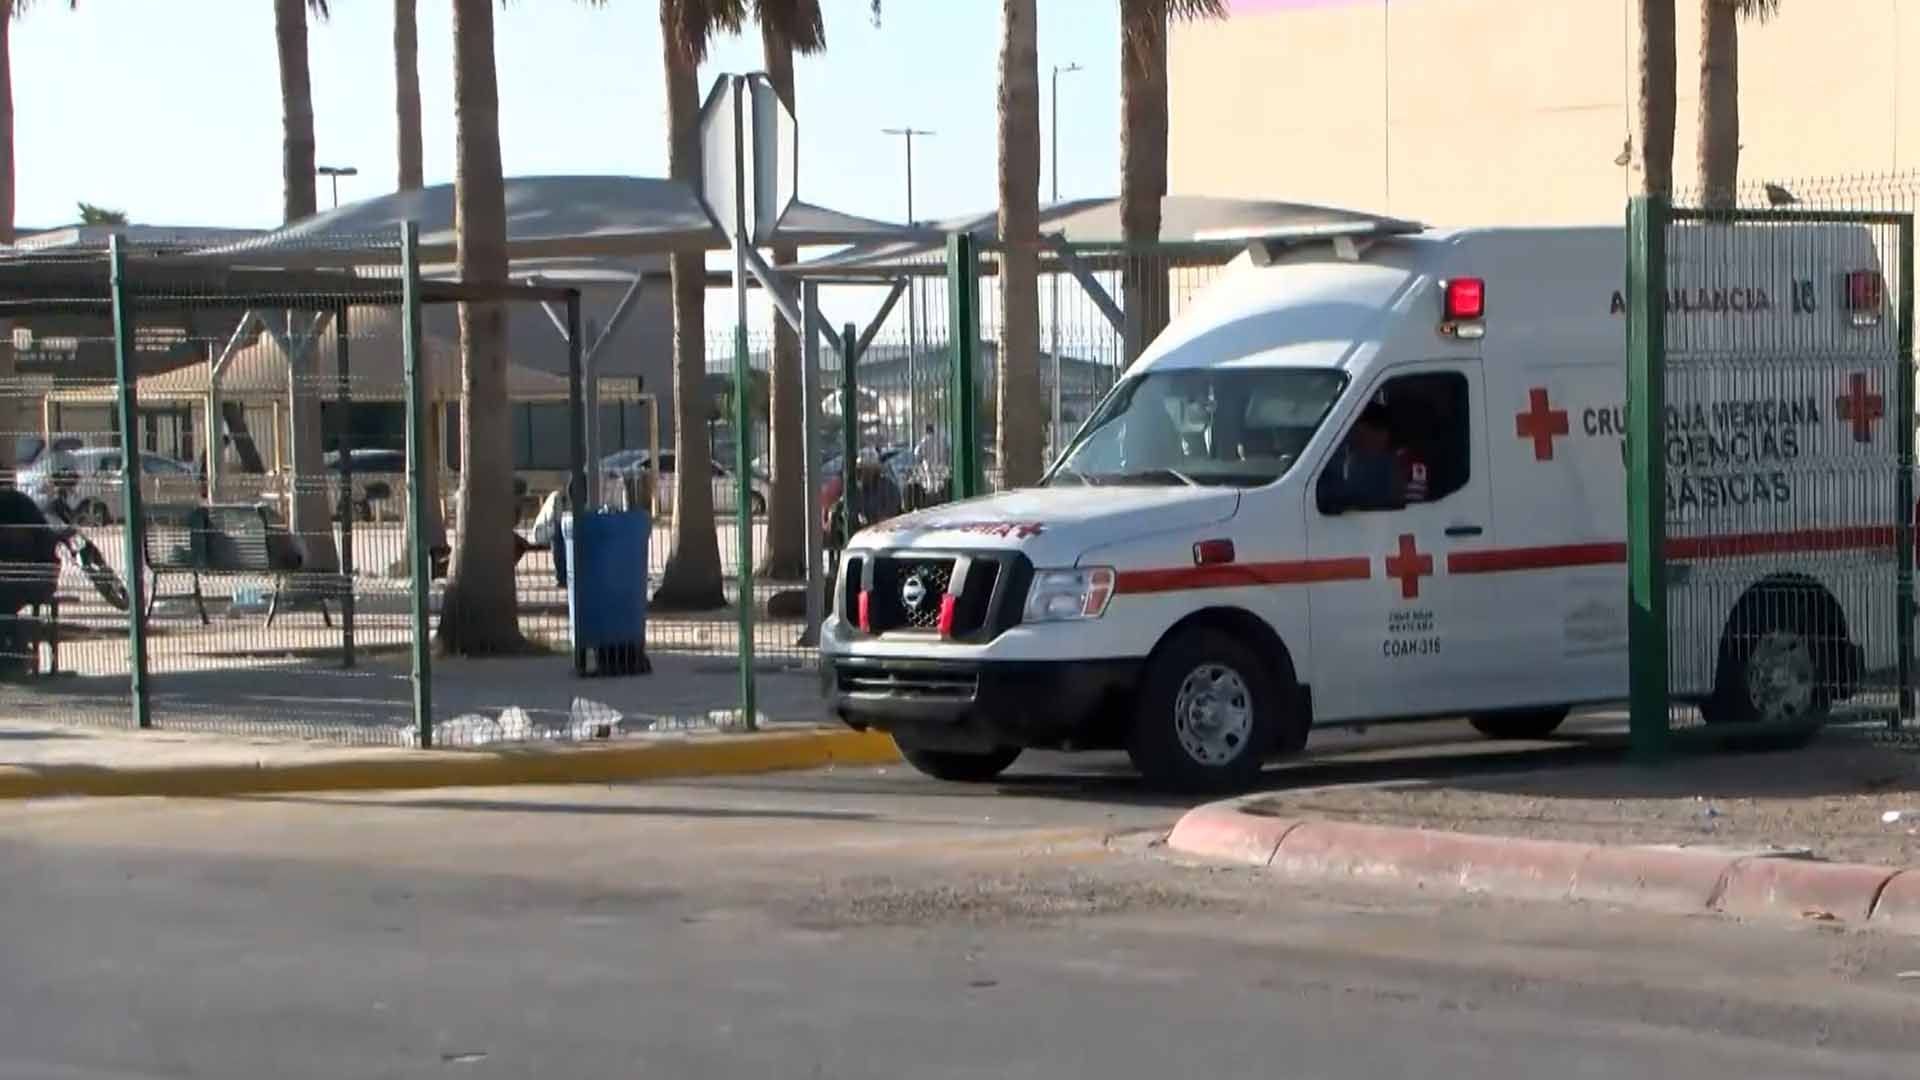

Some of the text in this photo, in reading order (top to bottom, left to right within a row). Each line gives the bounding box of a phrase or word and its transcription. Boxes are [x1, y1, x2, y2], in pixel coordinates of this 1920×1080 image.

[1610, 287, 1770, 315] AULANCIA
[1583, 397, 1819, 436] CRU OJA MEXICANA
[1621, 430, 1799, 469] GENCIAS
